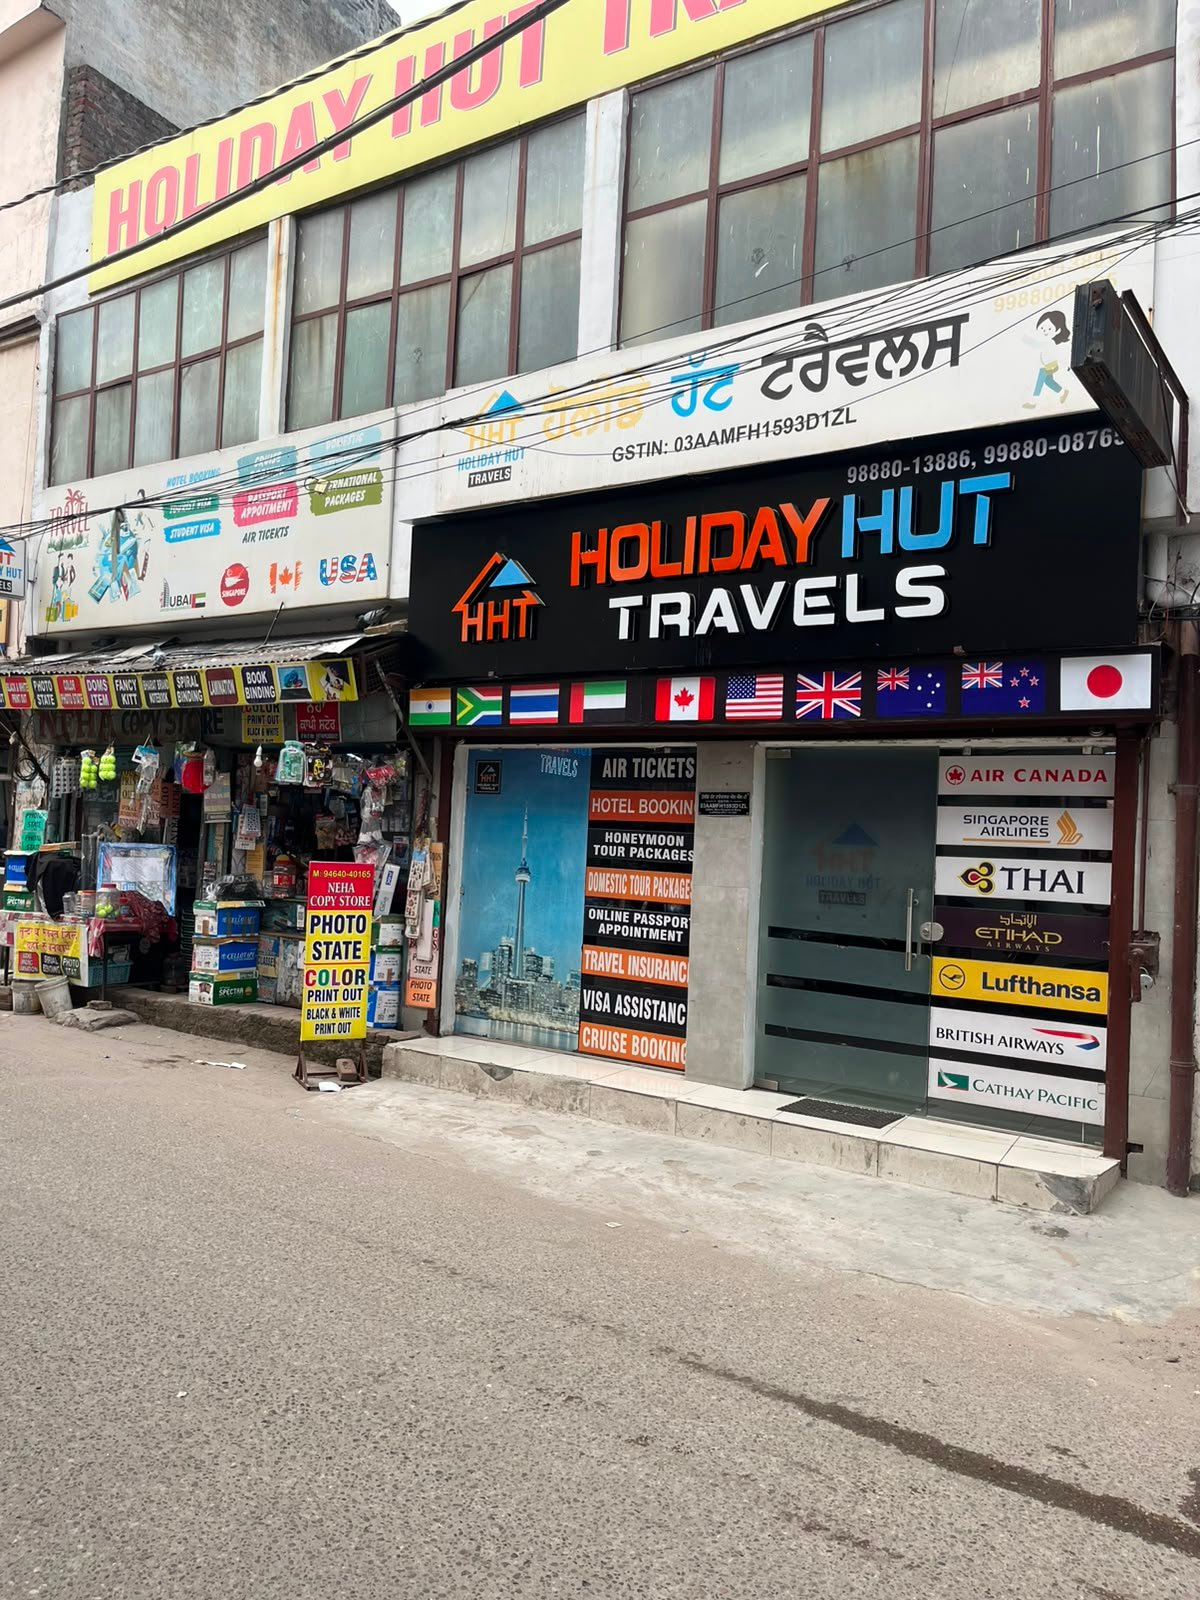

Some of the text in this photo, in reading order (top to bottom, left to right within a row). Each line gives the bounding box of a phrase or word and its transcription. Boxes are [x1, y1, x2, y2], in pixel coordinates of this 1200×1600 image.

[107, 73, 373, 256] HOLIDAY
[391, 0, 547, 139] HUT
[760, 312, 970, 401] ਟਰੈਵਲਸ
[612, 407, 857, 463] GSTIN: 03AAMFH1593D1ZL
[458, 447, 526, 472] HOLIDAY HUT
[846, 449, 977, 484] 98880-13886,
[166, 474, 188, 488] HOTEL
[470, 468, 511, 486] TRAVELS
[324, 490, 366, 507] PACKAGES
[241, 500, 293, 519] APPOITMENT
[170, 522, 215, 539] STUDENT VISA
[242, 526, 290, 544] AIR TICEKTS
[570, 472, 1011, 587] HOLIDAY HUT
[6, 568, 23, 580] HUT
[319, 552, 378, 587] USA
[221, 587, 246, 599] SINGAPORE
[609, 564, 946, 640] TRAVELS
[458, 590, 542, 642] HHT
[86, 679, 108, 692] DOMS
[115, 678, 137, 691] FANCY
[176, 675, 199, 688] SPIRAL
[245, 670, 268, 684] BOOK
[33, 680, 53, 692] PHOTO
[208, 679, 236, 696] LAMINATION
[244, 685, 276, 699] BINDING
[37, 693, 55, 705] STATE
[90, 693, 110, 706] ITEM
[121, 693, 138, 706] KITT
[177, 689, 203, 702] BINDING
[242, 703, 280, 713] COLOR
[247, 715, 279, 725] PRINT OUT
[247, 727, 260, 736] BLACK
[265, 727, 279, 736] WHITE
[540, 753, 579, 778] TRAVELS
[602, 756, 695, 779] AIR TICKETS
[970, 768, 1108, 783] AIR CANADA
[592, 797, 695, 816] HOTEL BOOKIN
[963, 814, 1049, 826] SINGAPORE
[605, 832, 685, 847] HONEYMOON
[980, 826, 1049, 838] AIRLINES
[593, 844, 694, 862] TOUR PACKAGES
[312, 869, 371, 878] M: 94640-40165
[999, 866, 1085, 894] THAI
[327, 882, 355, 894] NEHA
[588, 871, 628, 895] DOMESTIC
[630, 874, 651, 896] TOUR
[310, 895, 337, 907] COPY
[338, 895, 371, 907] STORE
[309, 914, 367, 935] PHOTO
[588, 908, 691, 929] ONLINE PASSPOR
[598, 923, 684, 943] APPOINTMENT
[975, 926, 1063, 945] ETIHAD
[312, 940, 362, 961] STATE
[986, 942, 1051, 952] AIRWAYS
[62, 957, 80, 967] PHOTO
[413, 965, 432, 975] STATE
[584, 949, 689, 983] TRAVEL INSURANC
[304, 968, 366, 987] COLOR
[410, 981, 433, 990] PHOTO
[981, 971, 1101, 1002] Lufthansa
[307, 988, 364, 1003] PRINT OUT
[412, 992, 431, 1002] STATE
[306, 1006, 361, 1020] BLACK & WHITE
[583, 988, 687, 1026] VISA ASSISTANC
[314, 1021, 352, 1035] PRINT OUT
[582, 1026, 687, 1065] CRUISE BOOKING
[936, 1026, 1064, 1056] BRITISH AIRWAYS
